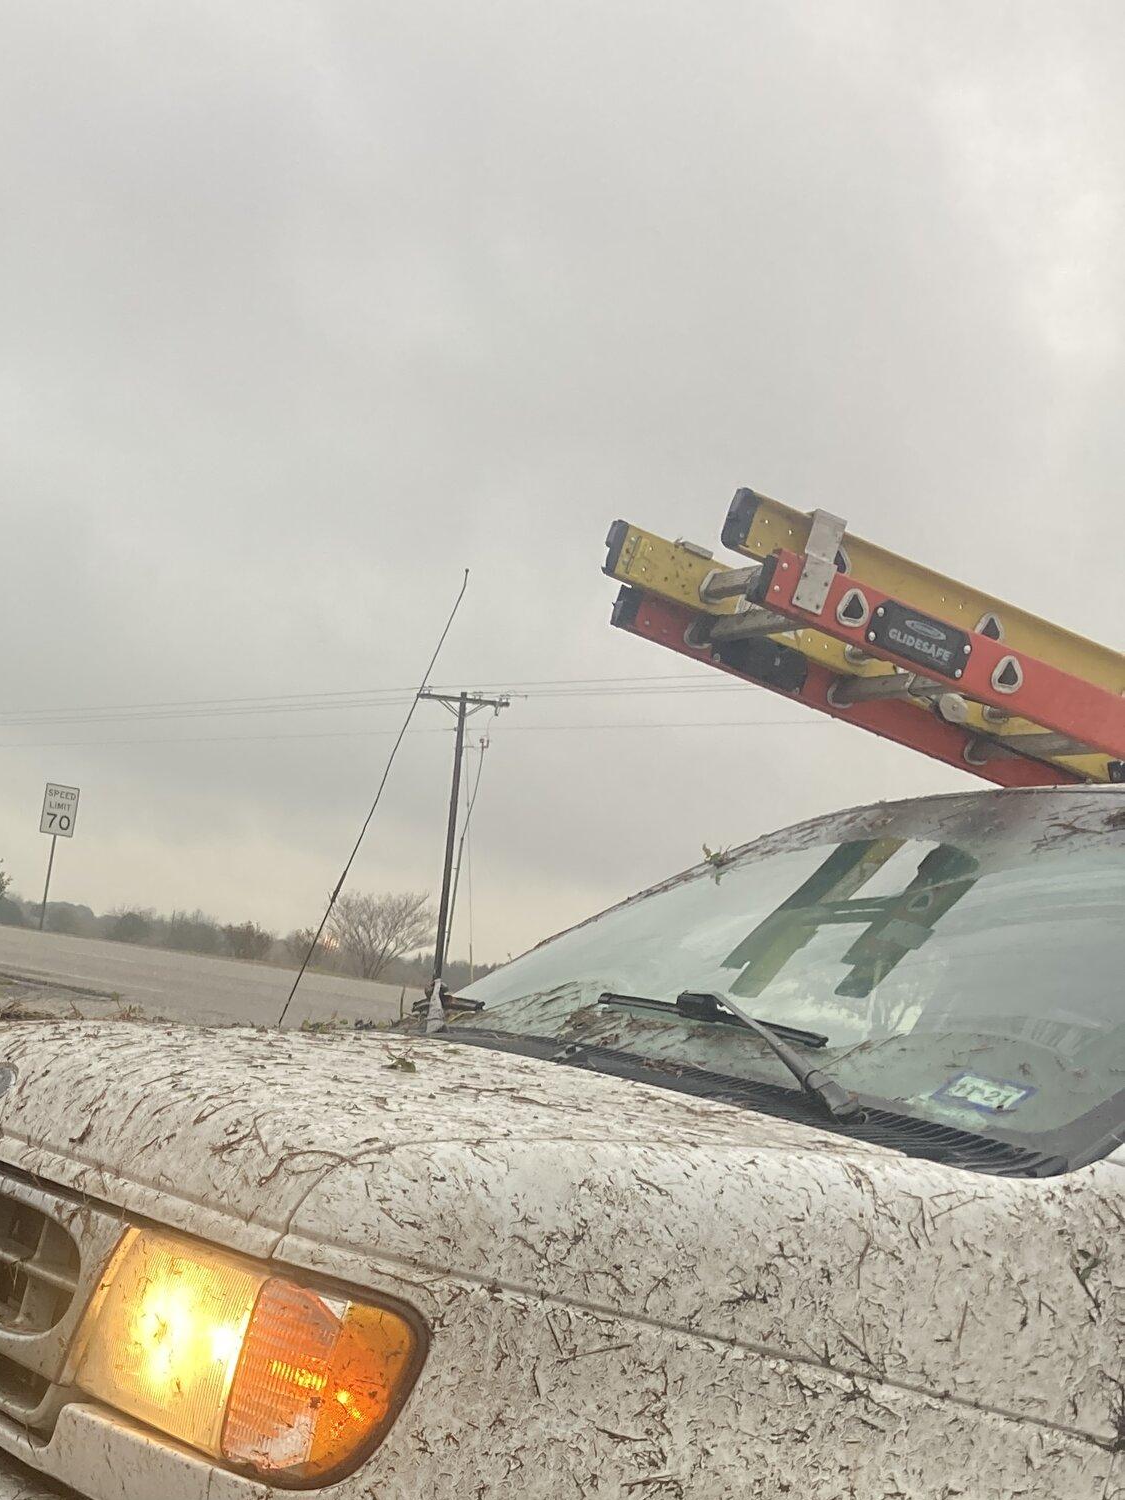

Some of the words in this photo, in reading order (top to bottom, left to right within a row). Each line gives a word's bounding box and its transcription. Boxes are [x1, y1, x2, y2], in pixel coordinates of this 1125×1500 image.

[889, 628, 953, 661] GLIDESAFE
[48, 788, 77, 801] SPEED
[49, 801, 72, 812] LIMIT
[46, 812, 71, 831] 70
